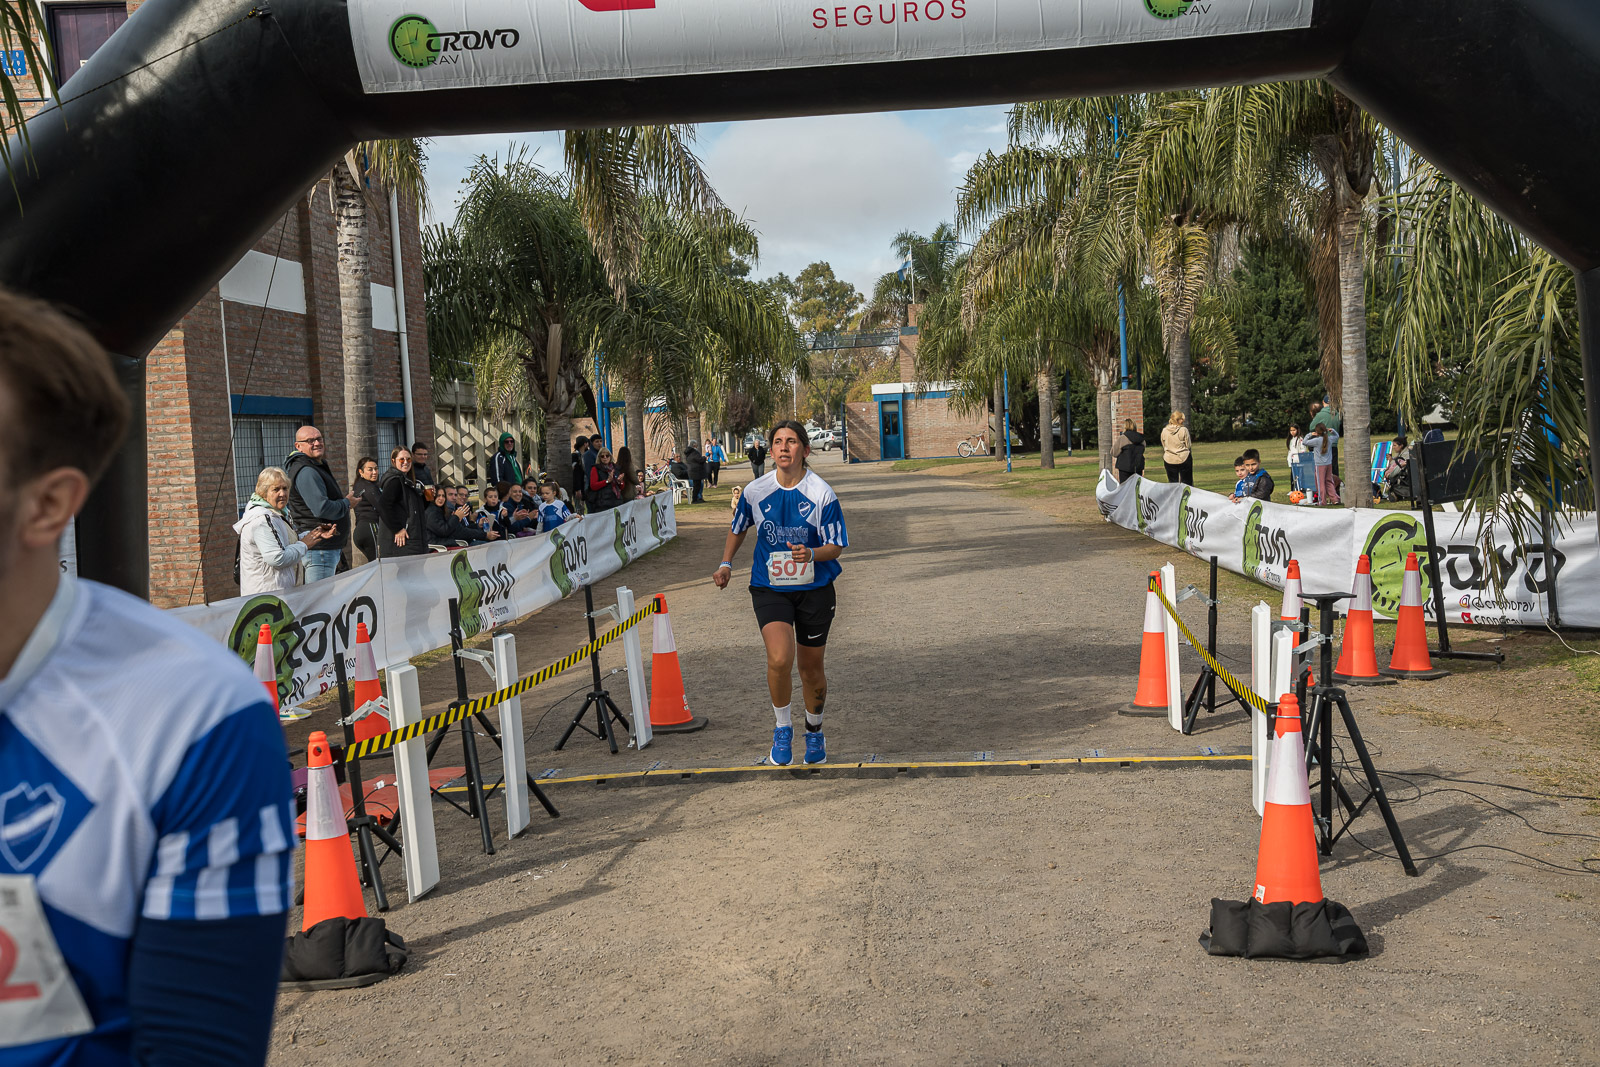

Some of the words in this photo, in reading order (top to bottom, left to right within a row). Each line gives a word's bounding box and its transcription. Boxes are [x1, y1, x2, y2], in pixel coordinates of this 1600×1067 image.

[812, 0, 967, 29] SEGUROS
[1177, 3, 1211, 16] RAV
[425, 28, 520, 53] CRONO
[426, 54, 459, 66] RAV
[763, 520, 778, 546] 3
[771, 559, 808, 577] 507
